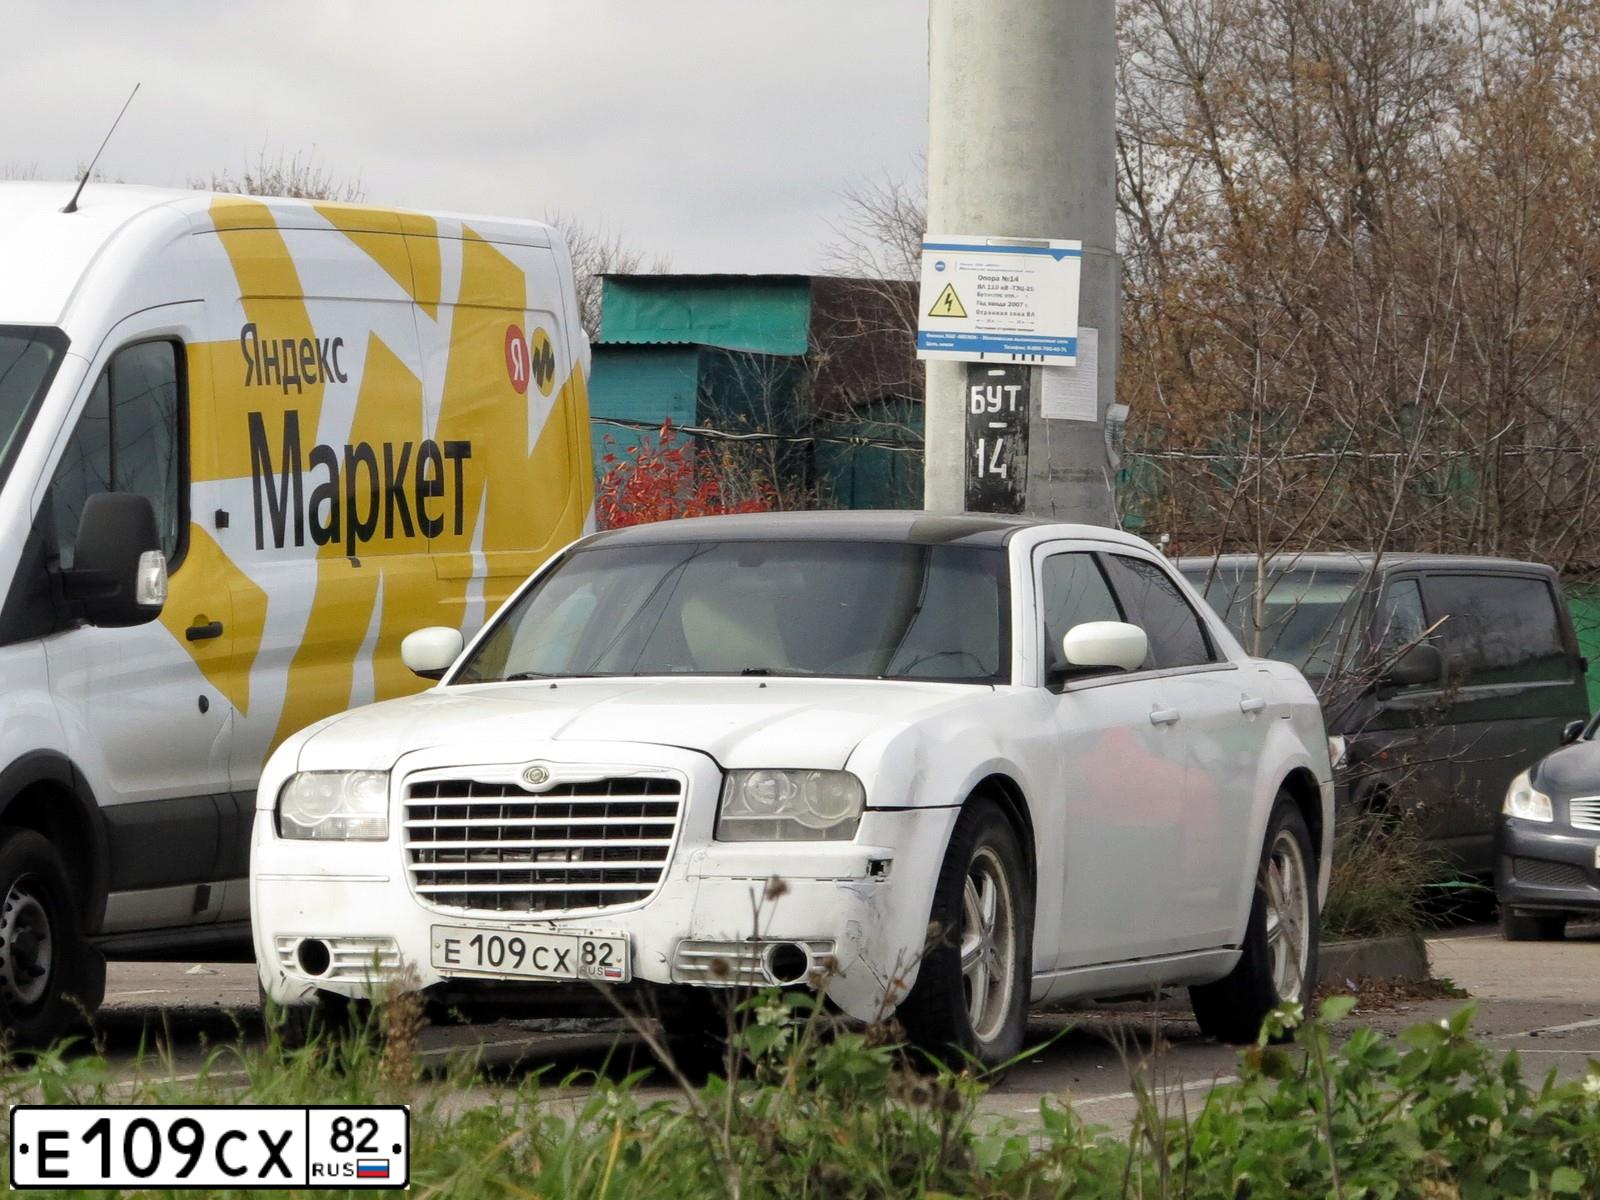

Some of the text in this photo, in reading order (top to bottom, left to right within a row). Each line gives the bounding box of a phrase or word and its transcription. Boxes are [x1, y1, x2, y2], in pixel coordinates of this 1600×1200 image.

[241, 323, 348, 395] Яндекс
[511, 338, 524, 381] Я
[971, 385, 1024, 415] БУТ.
[976, 438, 1007, 479] 14
[247, 409, 472, 567] Маркет
[579, 965, 603, 976] RUS
[581, 941, 613, 967] 82
